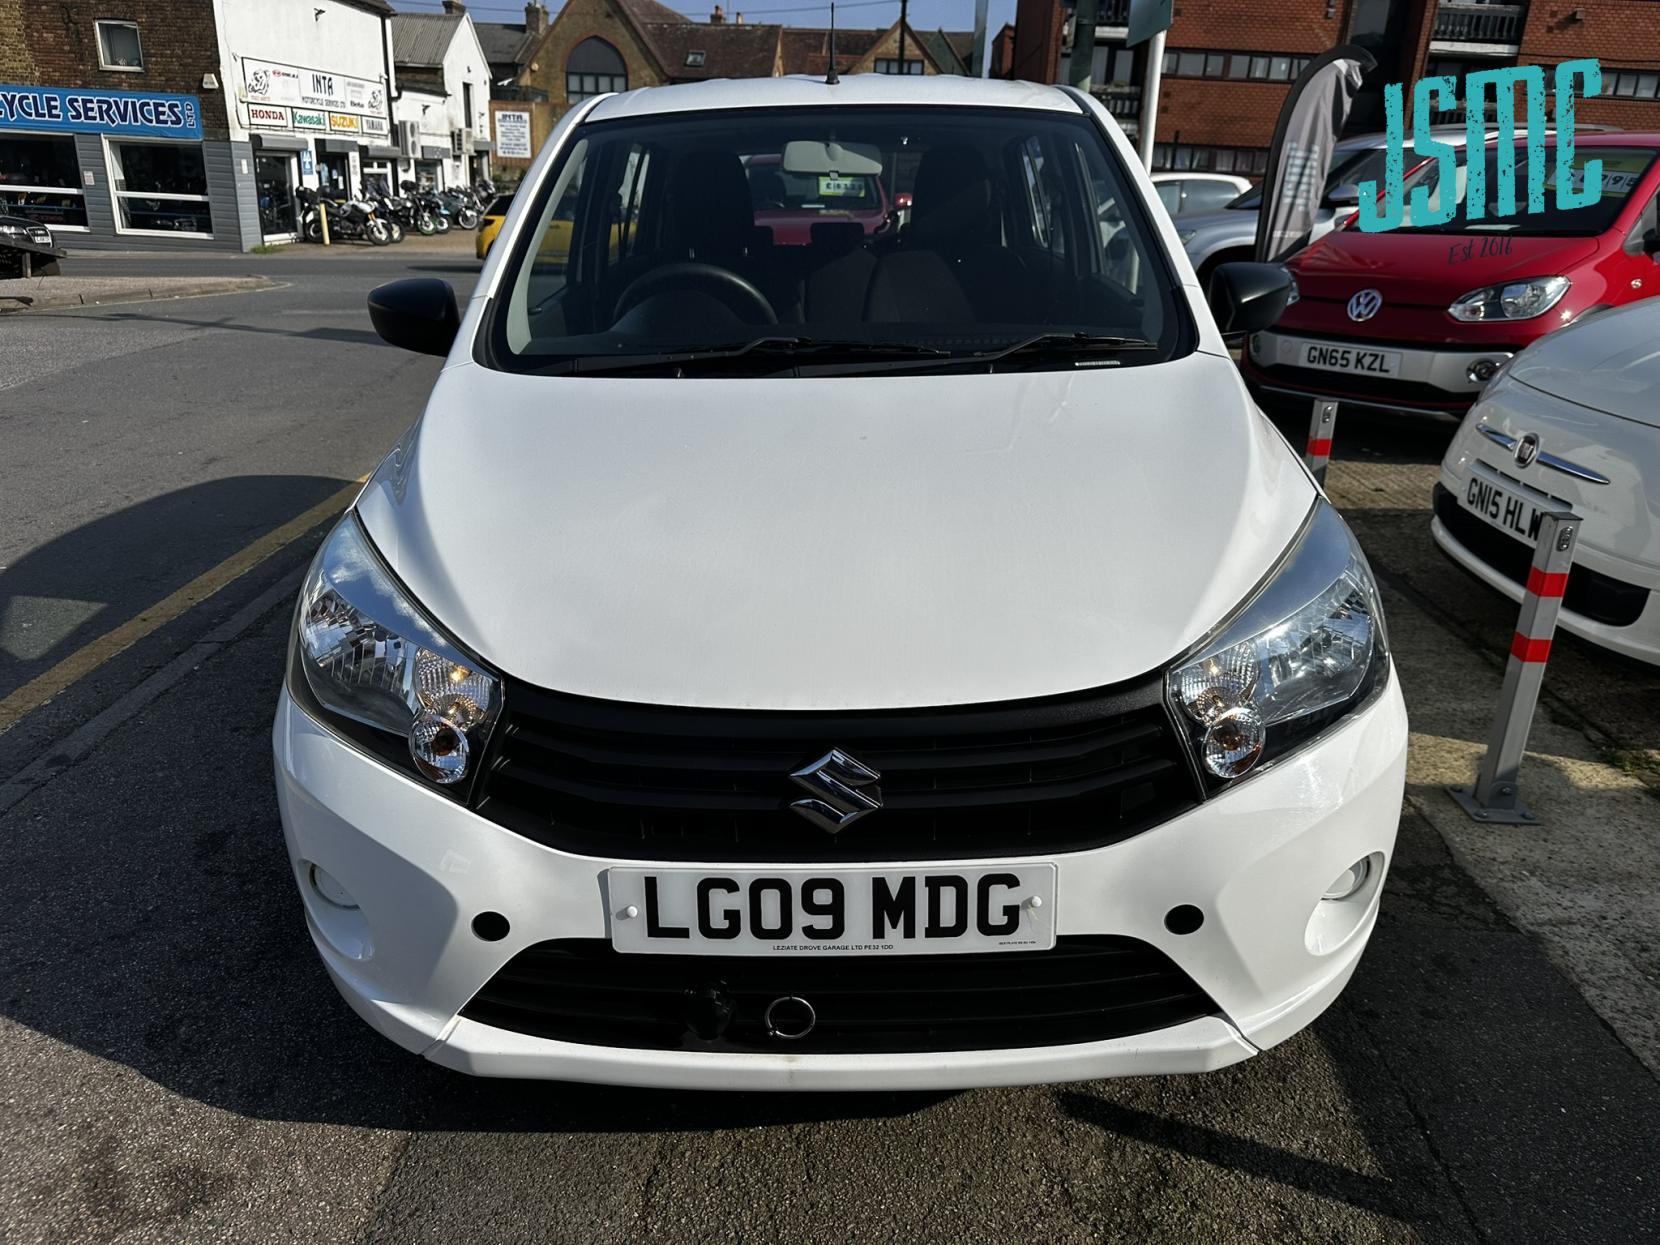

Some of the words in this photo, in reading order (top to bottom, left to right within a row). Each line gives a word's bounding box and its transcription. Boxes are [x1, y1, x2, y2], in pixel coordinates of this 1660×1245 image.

[312, 73, 334, 96] INTA
[0, 92, 61, 121] YCLE
[67, 95, 183, 127] SERVICES
[185, 102, 196, 128] LTD
[251, 109, 285, 121] HONDA
[294, 111, 326, 127] Kawasaki
[331, 115, 359, 129] SUZUKI
[1307, 346, 1351, 368] GN65
[1354, 351, 1390, 373] KZL
[1467, 477, 1503, 520] GN15
[644, 876, 846, 940] LG09
[872, 873, 1020, 940] MDG
